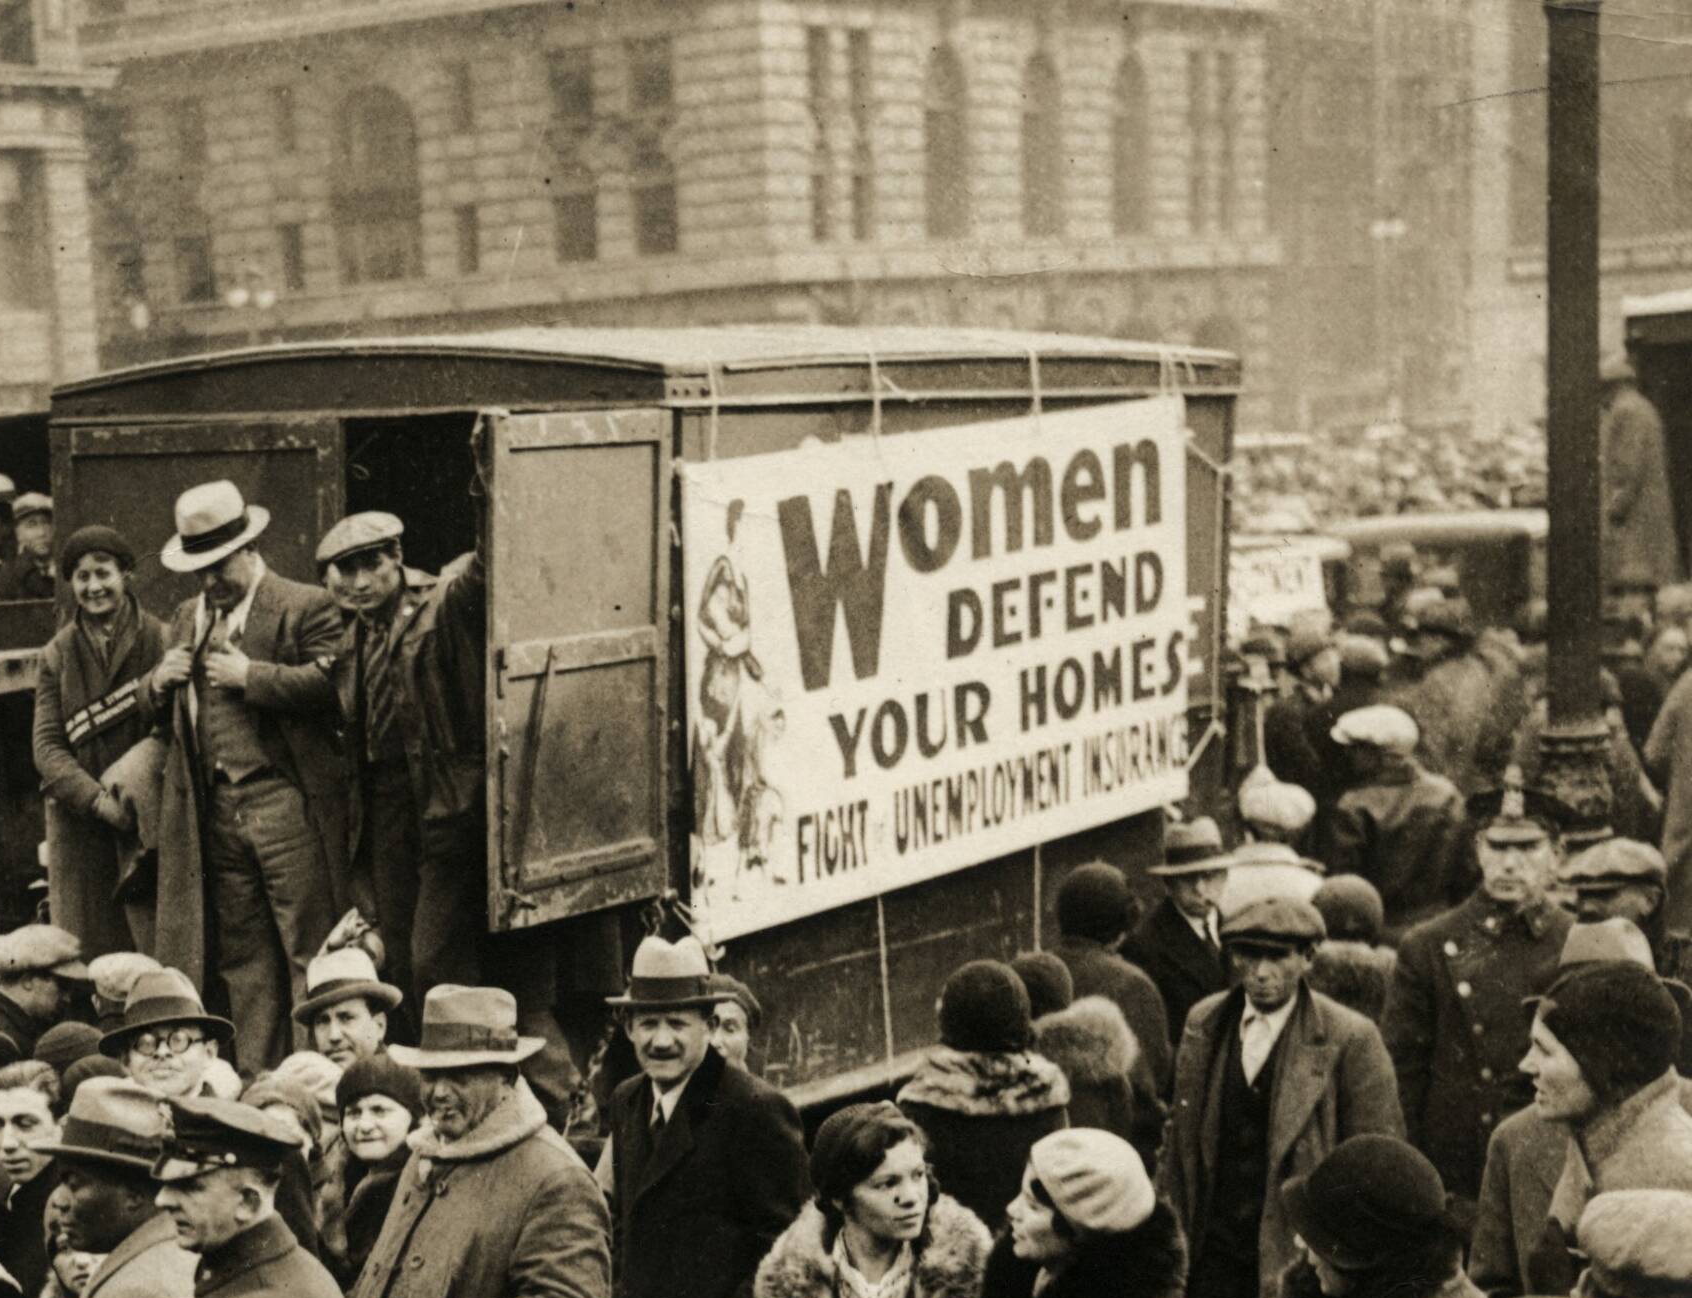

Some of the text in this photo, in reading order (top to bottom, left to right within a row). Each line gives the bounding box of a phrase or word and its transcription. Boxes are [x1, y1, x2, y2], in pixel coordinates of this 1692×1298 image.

[946, 551, 1164, 659] DEFEND
[828, 681, 991, 779] YOUR
[1019, 630, 1183, 732] HOMES
[797, 799, 869, 884] FIGHT
[894, 743, 1072, 856] UNEMPLOYMENT
